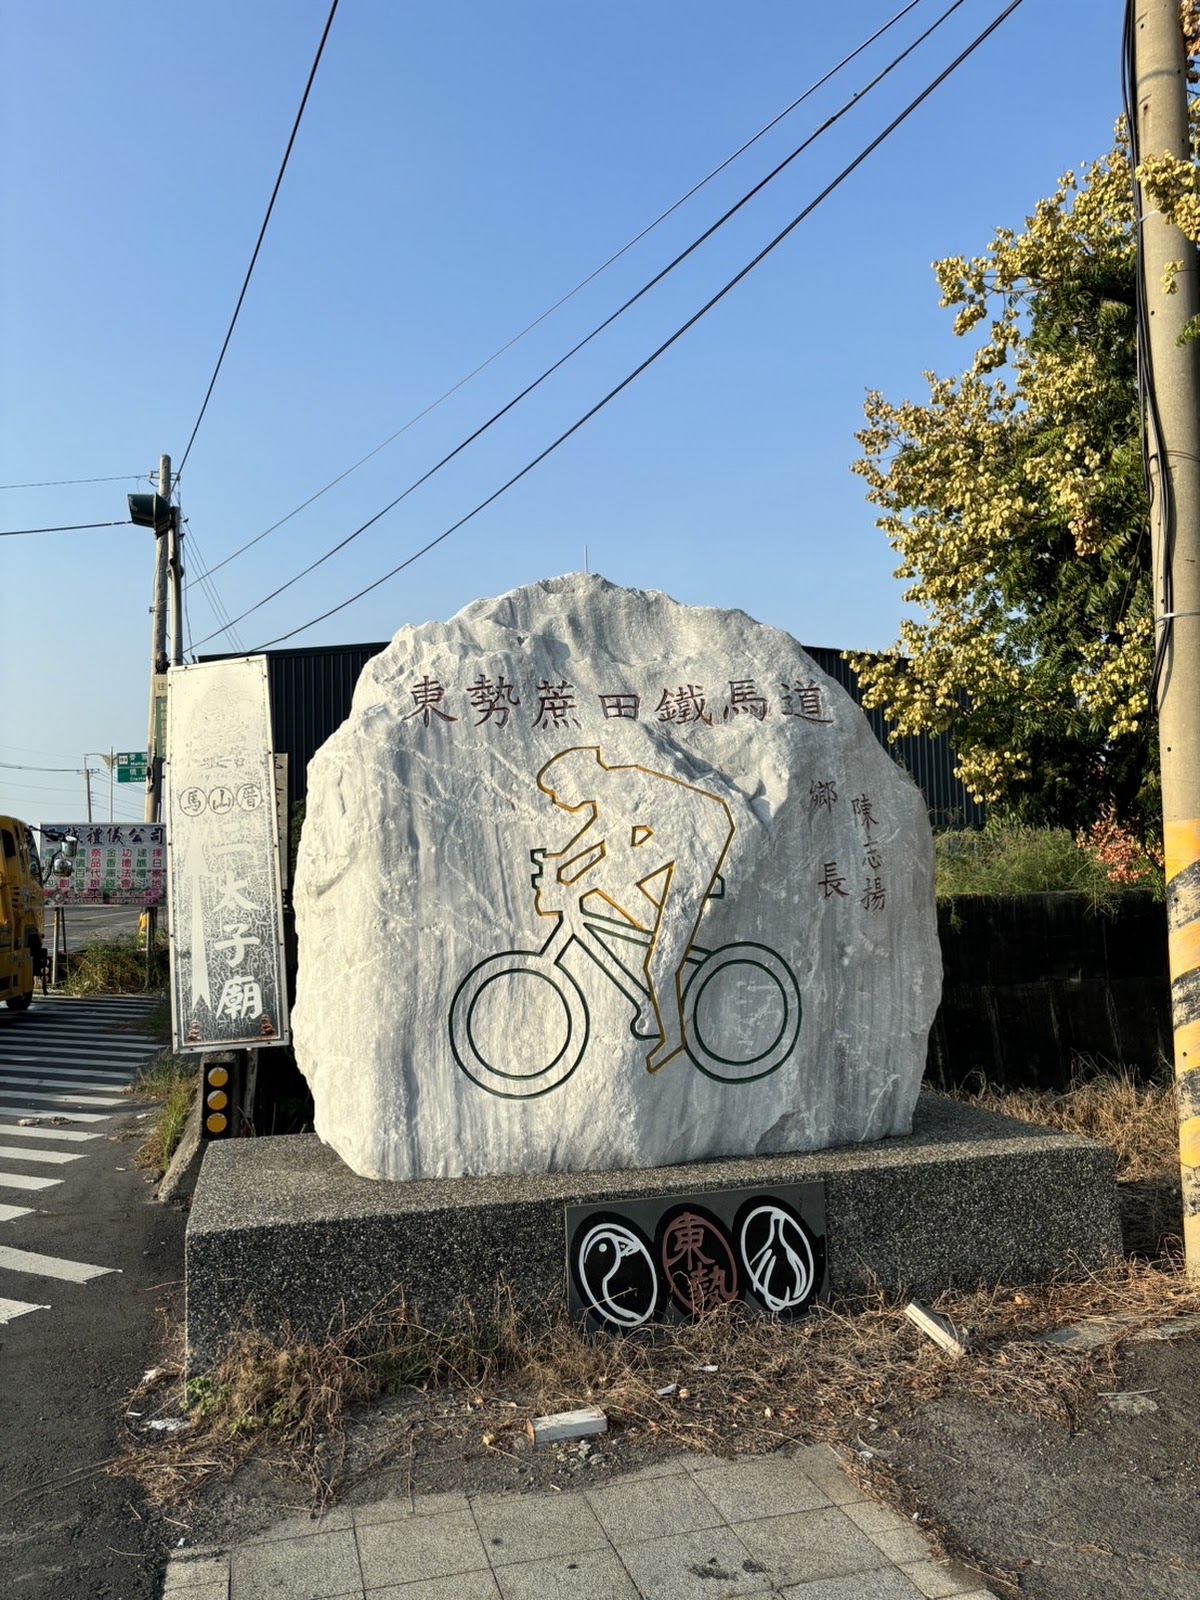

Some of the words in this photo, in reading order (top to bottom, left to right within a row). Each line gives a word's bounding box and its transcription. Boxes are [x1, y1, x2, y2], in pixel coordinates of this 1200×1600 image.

[402, 674, 834, 729] 東勢蔗田鐵馬道
[181, 785, 261, 815] 馬山厝
[810, 780, 849, 899] 鄉長
[852, 794, 886, 911] 陳志揚
[663, 1212, 739, 1313] 東勢
